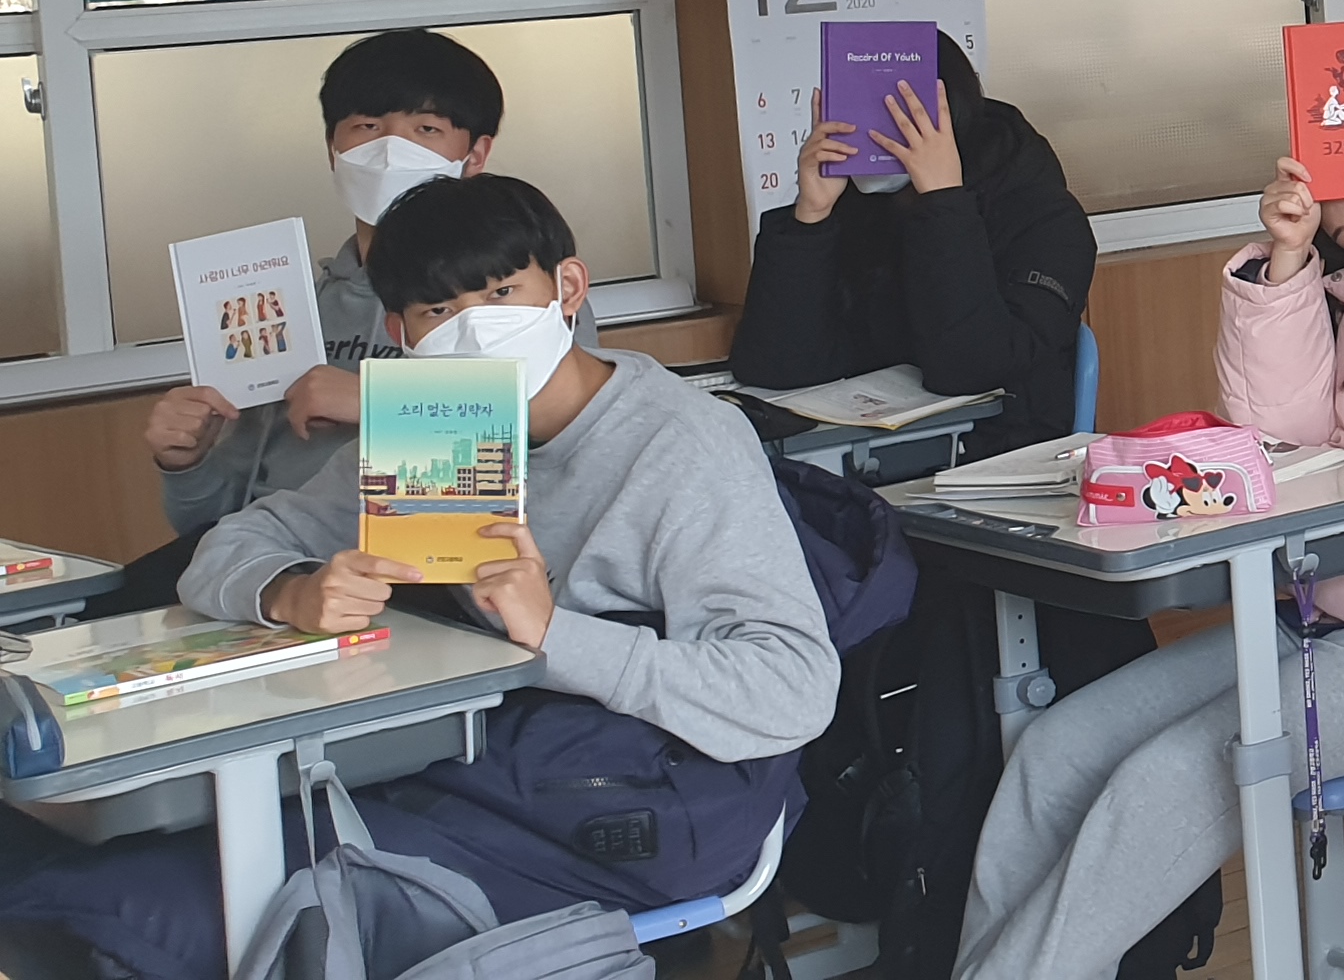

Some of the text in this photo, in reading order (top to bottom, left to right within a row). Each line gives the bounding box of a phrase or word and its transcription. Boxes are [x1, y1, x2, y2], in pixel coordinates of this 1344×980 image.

[965, 34, 974, 50] 5
[880, 52, 892, 62] Of
[757, 88, 801, 109] 6 7
[757, 132, 776, 150] 13
[760, 172, 779, 190] 20
[397, 402, 423, 417] 소리
